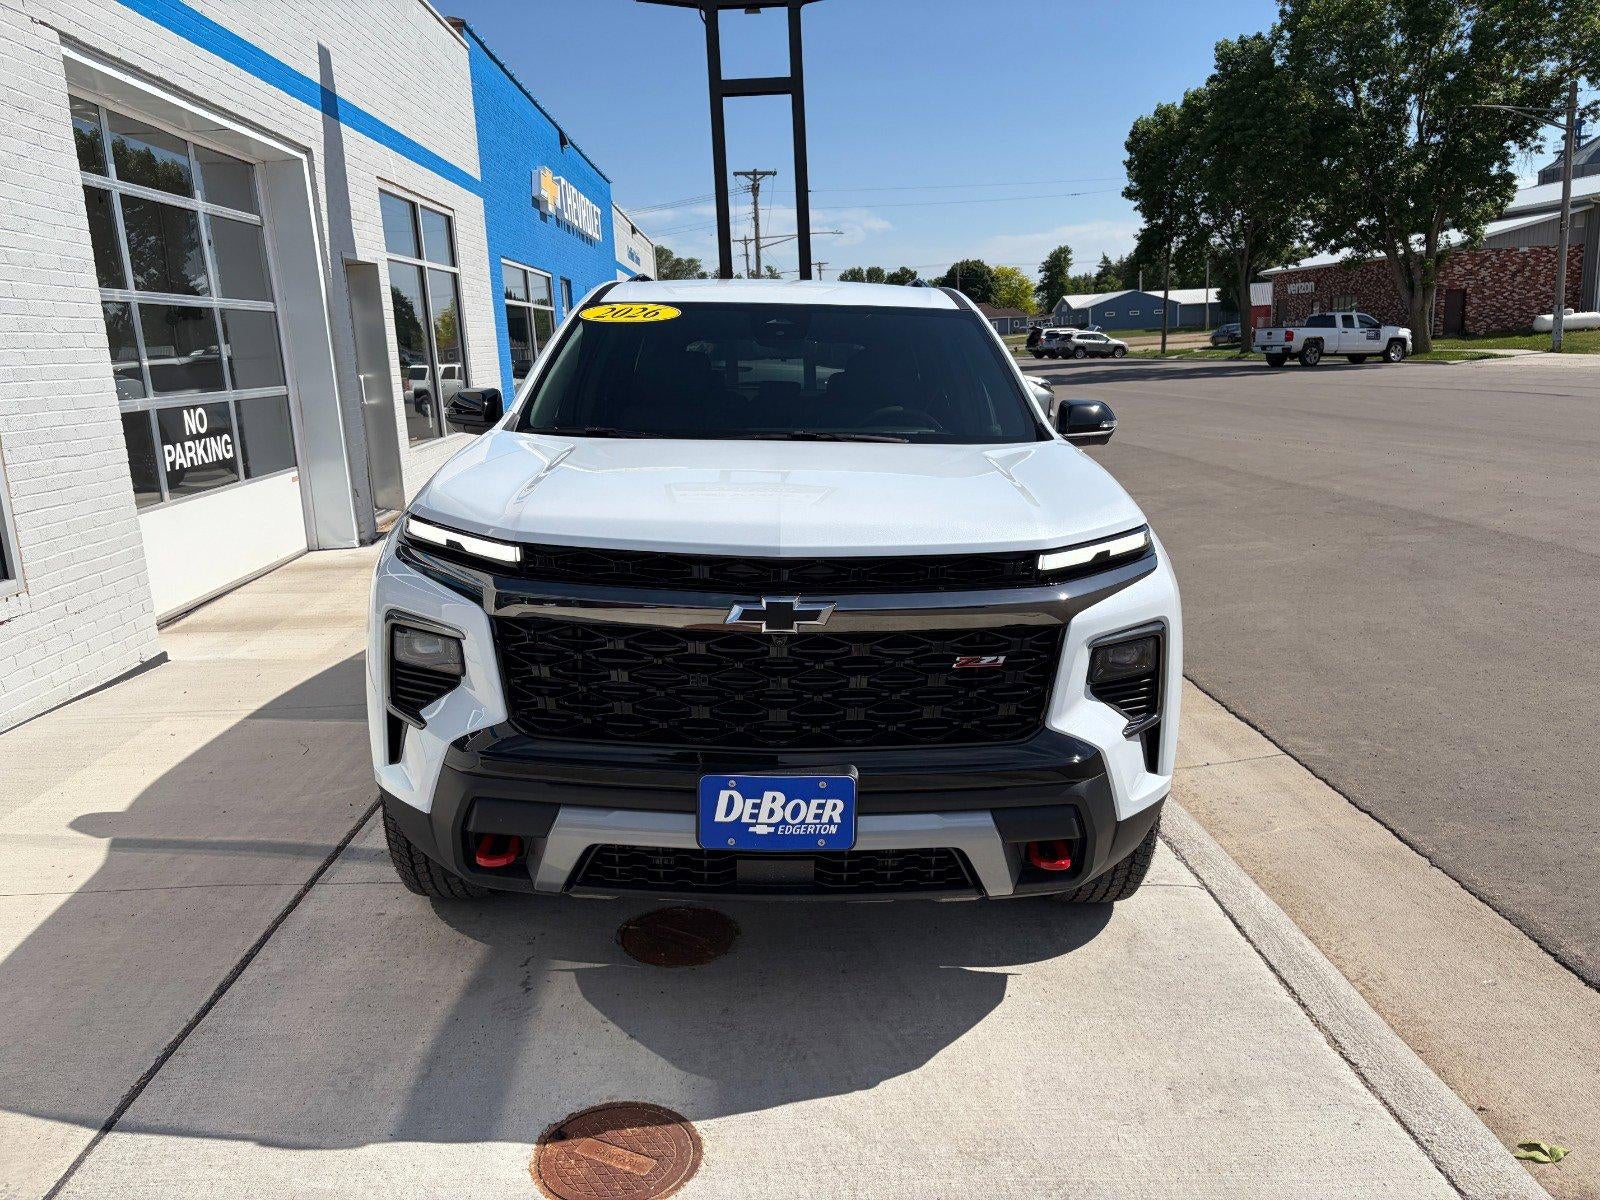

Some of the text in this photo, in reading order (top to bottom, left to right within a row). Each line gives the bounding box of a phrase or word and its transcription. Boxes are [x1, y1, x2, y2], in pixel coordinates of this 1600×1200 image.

[558, 175, 603, 242] CHEVROLET
[1287, 281, 1315, 295] verizon
[593, 306, 664, 319] 2026
[183, 407, 208, 436] NO
[163, 433, 234, 472] PARKING
[952, 655, 1006, 669] Z71
[777, 824, 838, 836] EDGERTON
